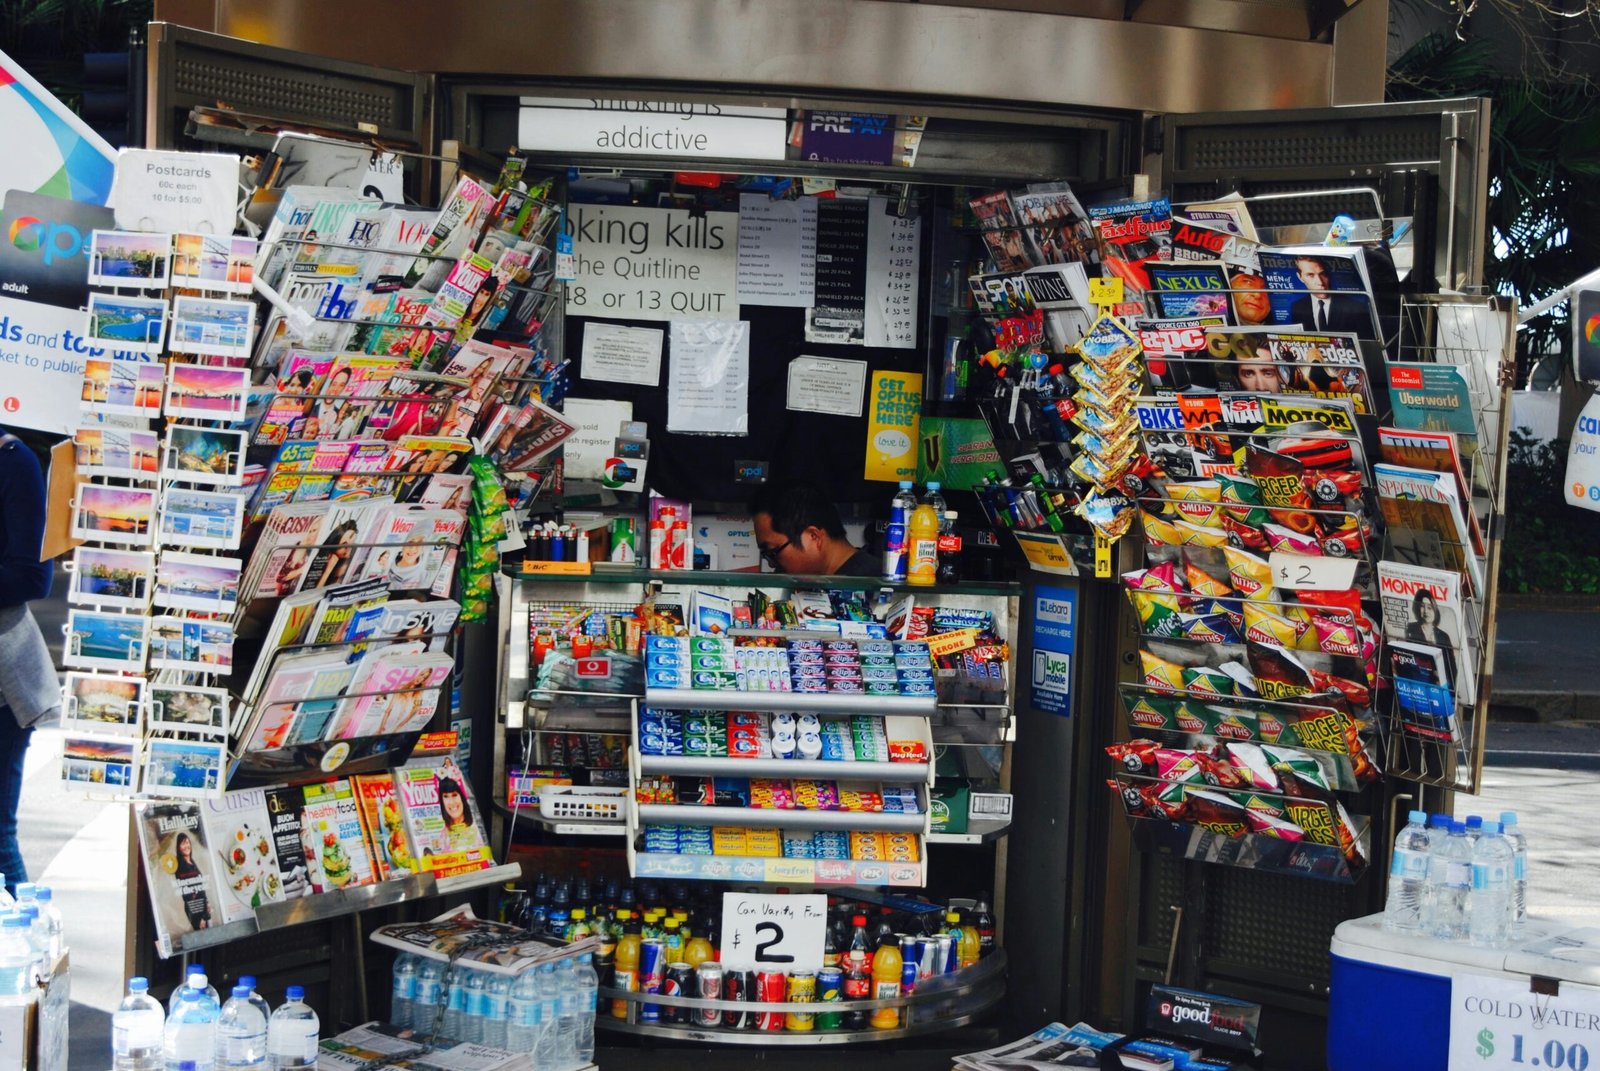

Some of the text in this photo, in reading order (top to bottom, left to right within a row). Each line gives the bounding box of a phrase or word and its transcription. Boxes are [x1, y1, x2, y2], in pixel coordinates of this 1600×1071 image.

[810, 114, 887, 135] PREPAY
[596, 125, 709, 151] addictive
[146, 163, 213, 179] Postcards
[164, 194, 176, 202] for
[665, 213, 724, 250] kills
[1101, 216, 1173, 239] Fastfours
[1174, 225, 1224, 250] Auto
[613, 256, 701, 280] Quitline
[2, 281, 29, 294] adult
[1156, 276, 1223, 290] NEXUS
[1266, 275, 1285, 283] MEN
[1028, 279, 1072, 300] WINE
[602, 292, 626, 308] or
[636, 289, 662, 310] 13
[670, 290, 727, 314] QUIT
[26, 332, 58, 349] and
[1139, 329, 1205, 352] apc
[25, 354, 39, 367] to
[1268, 341, 1359, 365] Kowledge
[388, 376, 421, 395] Who
[878, 377, 906, 390] GET
[1391, 376, 1421, 386] Economist
[877, 390, 921, 404] OPTUS
[1398, 391, 1460, 408] Uberworld
[875, 413, 914, 427] HERE
[1137, 407, 1185, 429] BIKE
[1267, 407, 1348, 428] MOTOR
[1578, 415, 1600, 436] ca
[581, 439, 611, 447] register
[877, 437, 908, 449] love it
[1387, 437, 1441, 462] TIME
[1575, 441, 1597, 456] your
[564, 452, 582, 460] only
[923, 434, 940, 474] V
[1574, 481, 1600, 500] T B
[727, 530, 750, 538] OPTUS
[1280, 565, 1316, 585] $ 2
[1044, 600, 1069, 616] Lebara
[385, 609, 459, 633] InStyle
[1059, 629, 1073, 639] HERE
[1046, 655, 1067, 675] Lyca
[1397, 653, 1417, 666] good
[380, 667, 450, 692] SHP
[1045, 673, 1066, 686] mobile
[646, 723, 674, 734] Extra
[690, 722, 718, 732] Extra
[646, 738, 675, 748] Extra
[690, 740, 719, 749] Extra
[906, 752, 924, 760] Red
[402, 783, 439, 807] Yours
[307, 805, 338, 819] healthy
[157, 813, 200, 833] Halliday
[737, 901, 824, 917] Can From
[731, 921, 795, 963] $ 2
[1171, 1004, 1212, 1025] good
[1464, 996, 1600, 1032] COLD WATER
[1475, 1027, 1590, 1071] $ 1.00
